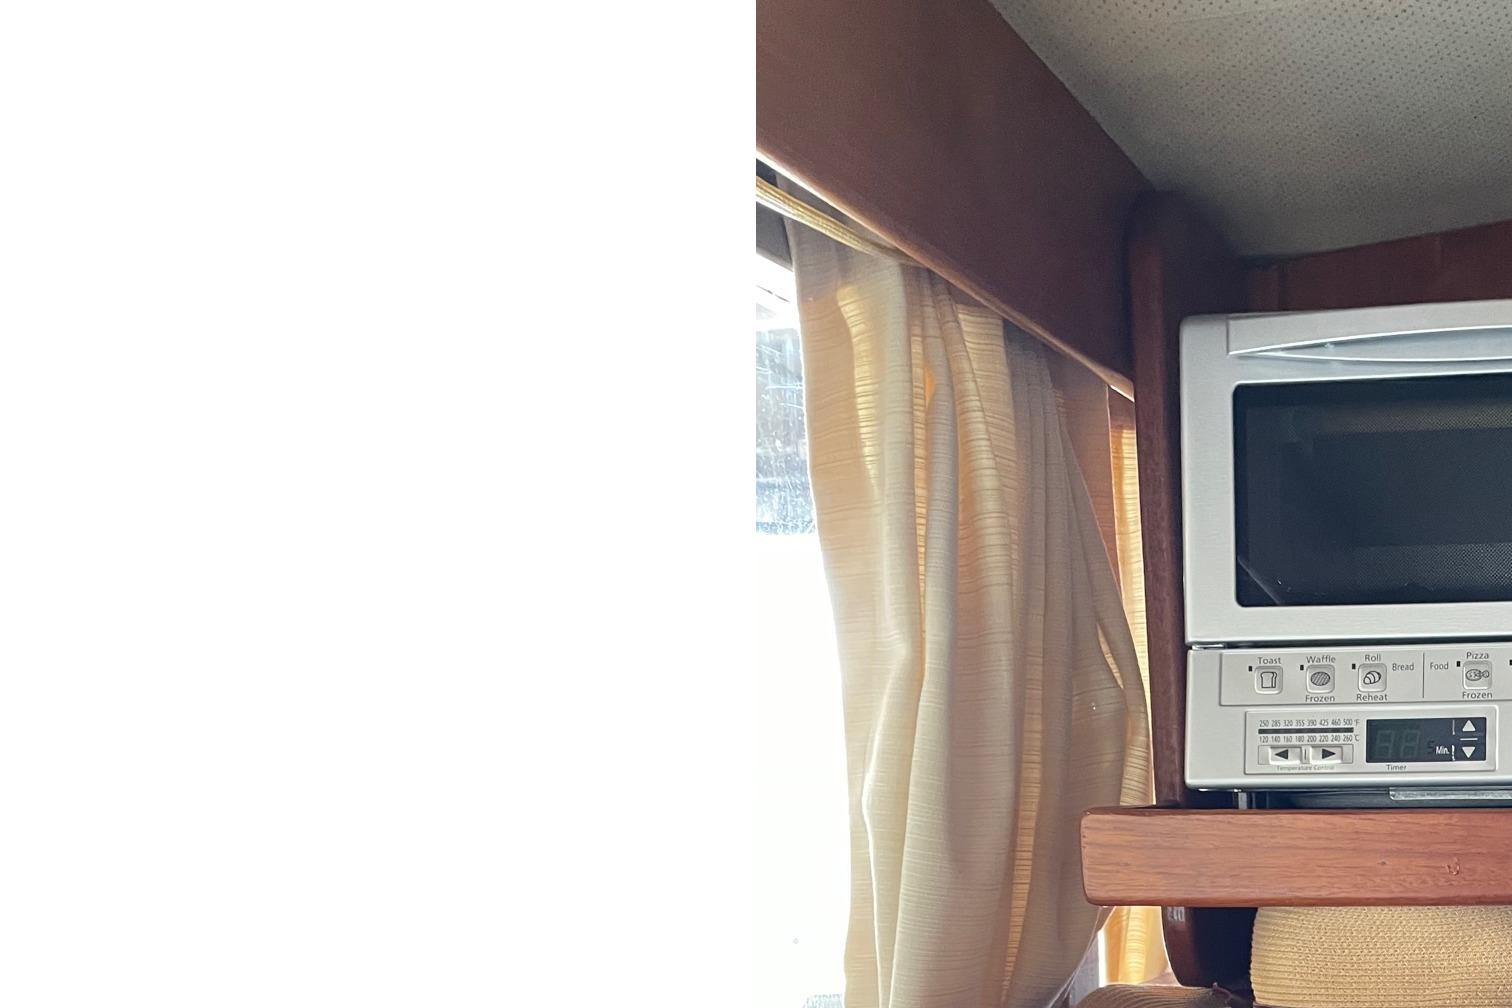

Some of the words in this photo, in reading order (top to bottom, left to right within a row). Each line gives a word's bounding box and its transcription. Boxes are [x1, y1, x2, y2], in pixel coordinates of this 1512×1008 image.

[1306, 654, 1336, 664] Waffle
[1364, 654, 1381, 662] Roll
[1466, 651, 1489, 659] Pizza
[1258, 656, 1282, 664] Toast
[1392, 662, 1415, 671] Bread
[1430, 661, 1449, 670] Food
[1305, 694, 1336, 703] Frozen
[1356, 693, 1388, 702] Reheat
[1462, 690, 1493, 699] Frozen
